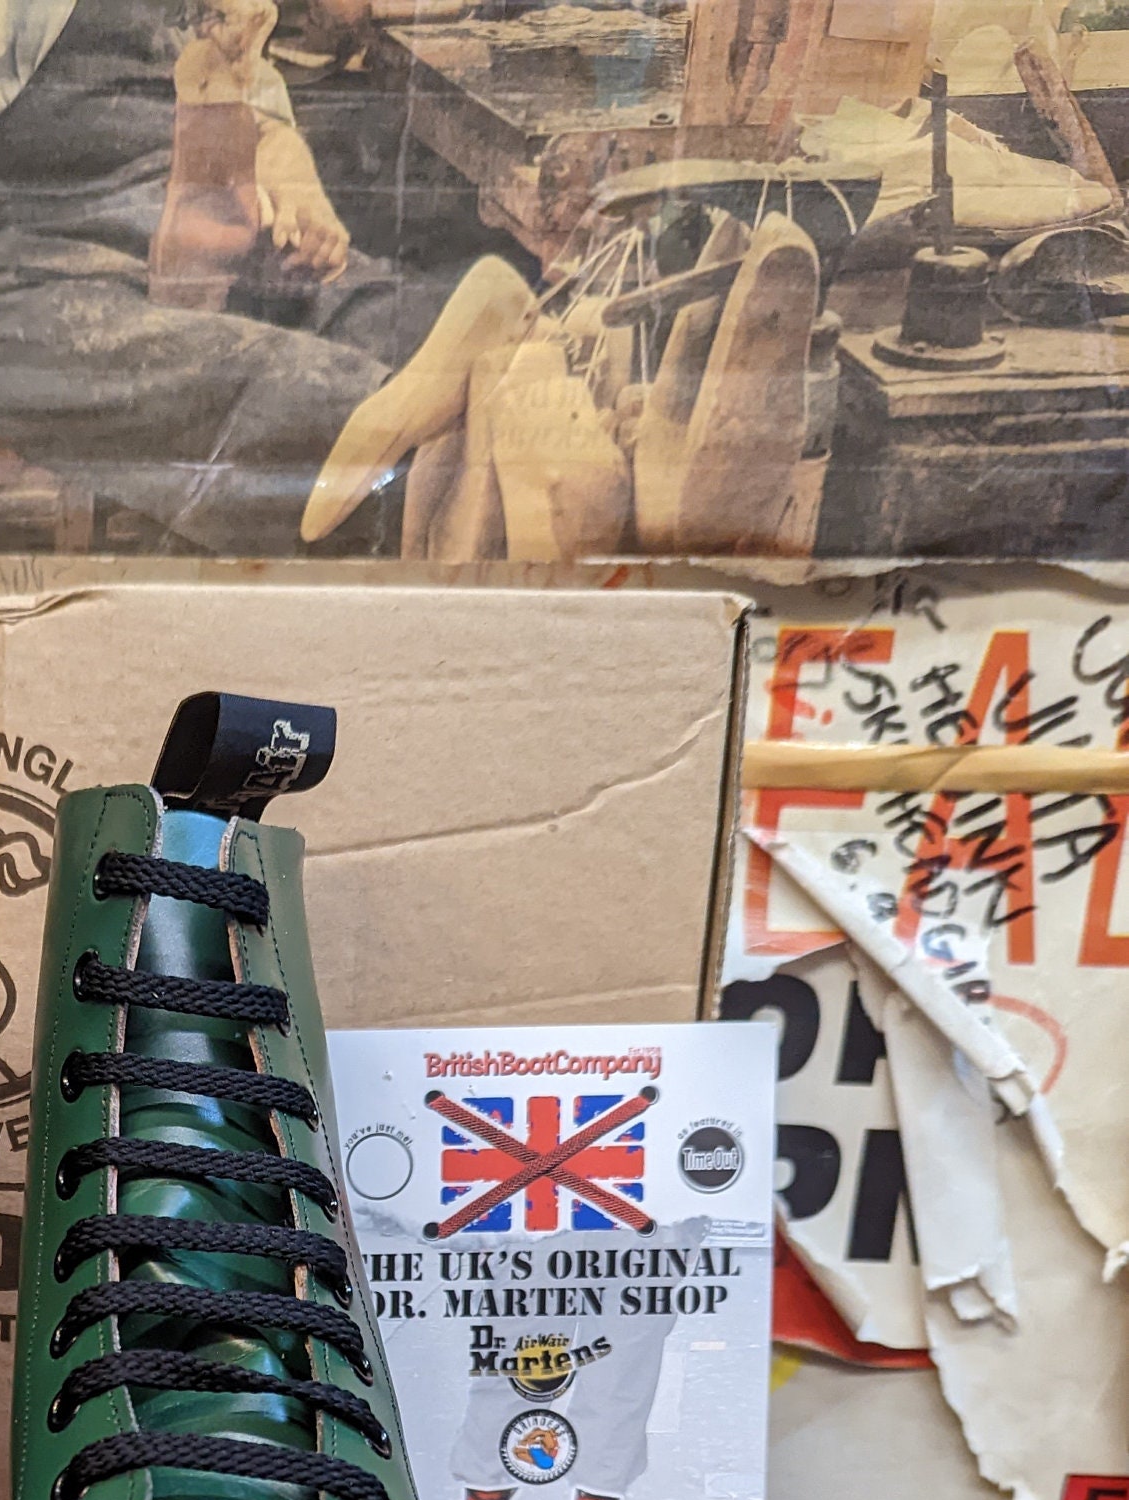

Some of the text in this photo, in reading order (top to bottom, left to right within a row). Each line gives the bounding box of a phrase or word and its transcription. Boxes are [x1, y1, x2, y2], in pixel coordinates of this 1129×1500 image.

[424, 1049, 662, 1080] BritishBootCompany
[362, 1248, 741, 1281] HE UK'S ORIGINAL
[443, 1287, 606, 1318] MARTEN
[620, 1285, 728, 1317] SHOP
[469, 1335, 613, 1377] Martens
